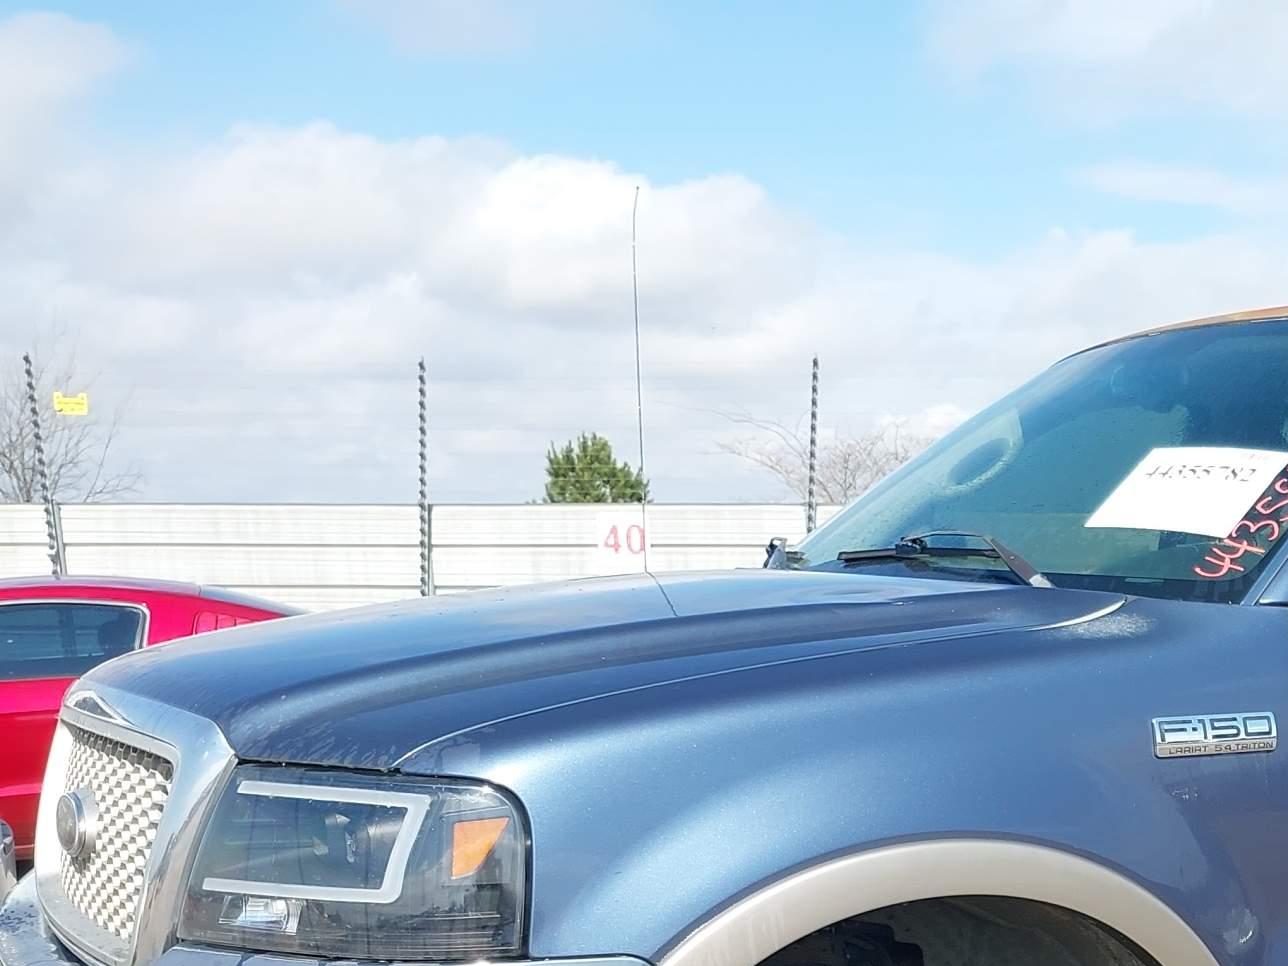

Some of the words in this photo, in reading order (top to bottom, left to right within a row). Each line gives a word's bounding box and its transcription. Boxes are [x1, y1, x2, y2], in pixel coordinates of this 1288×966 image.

[604, 524, 645, 554] 40
[1168, 745, 1209, 755] LARIAT
[1232, 741, 1274, 752] TRITON
